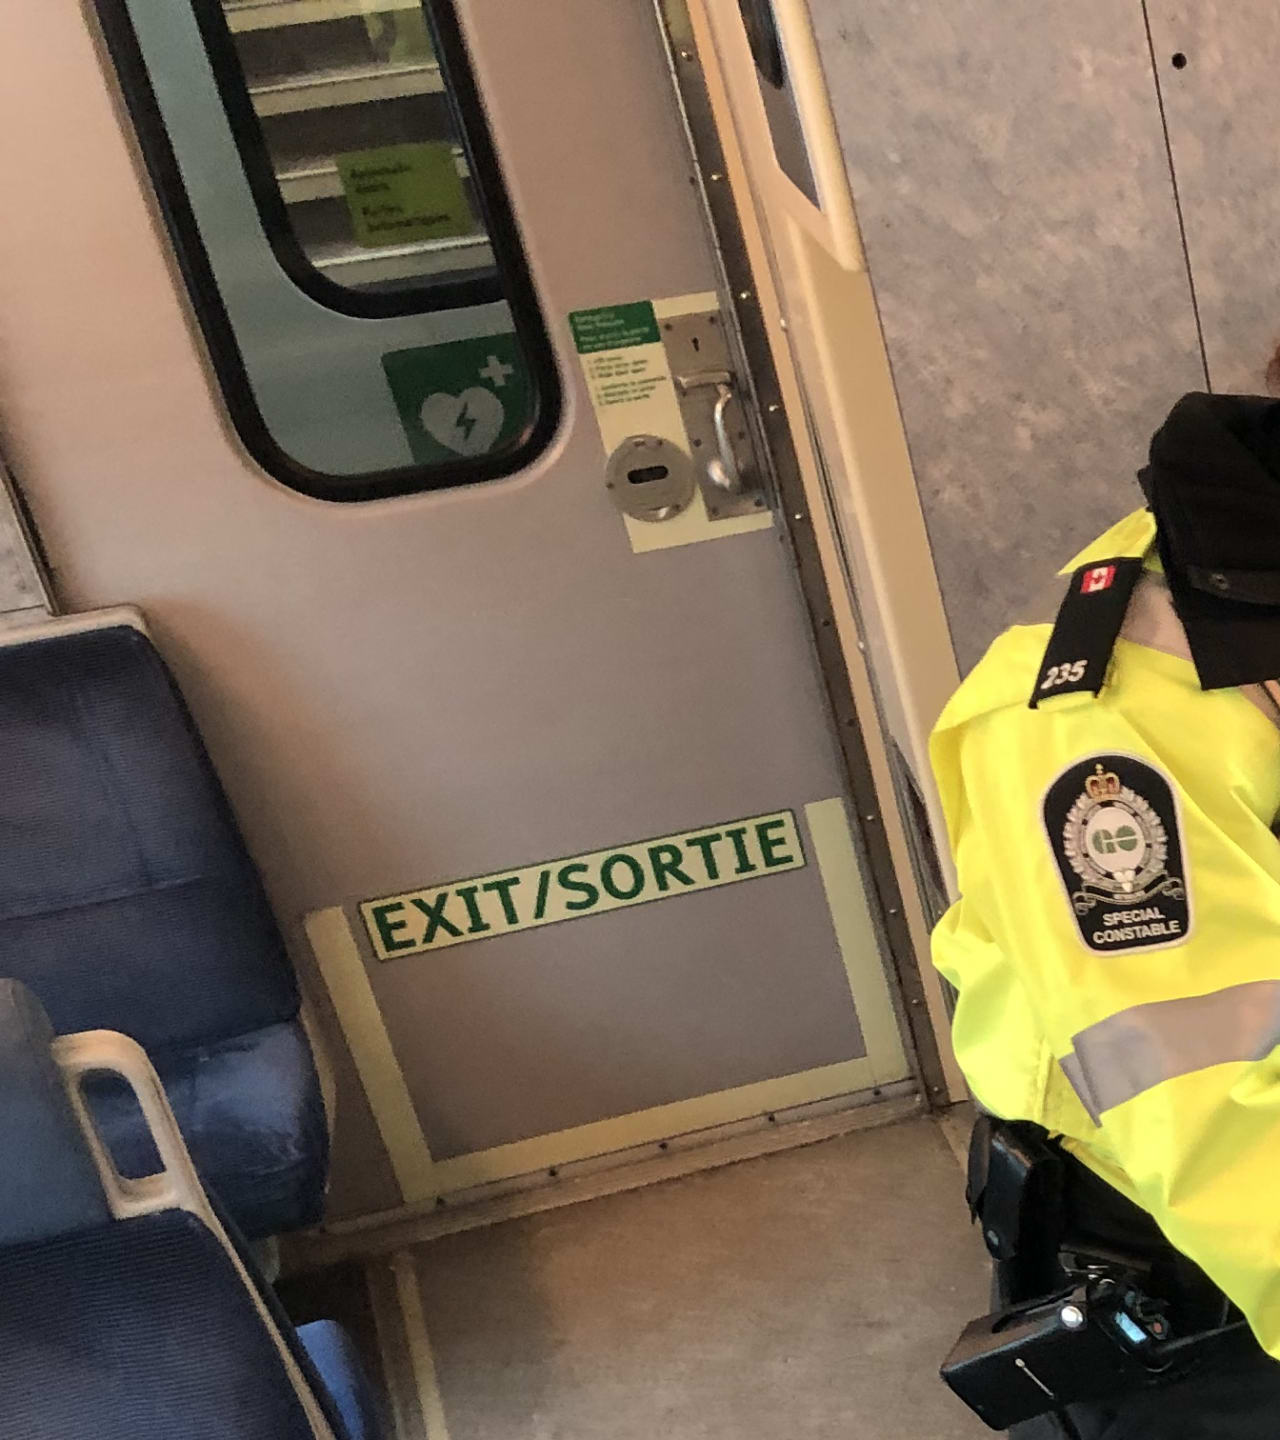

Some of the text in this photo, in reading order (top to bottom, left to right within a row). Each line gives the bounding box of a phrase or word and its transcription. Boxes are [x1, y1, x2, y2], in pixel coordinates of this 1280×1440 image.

[1041, 660, 1088, 689] 235
[371, 818, 794, 953] EXIT/SORTIE
[1102, 906, 1166, 927] SPECIAL
[1093, 919, 1181, 944] CONSTABLE
